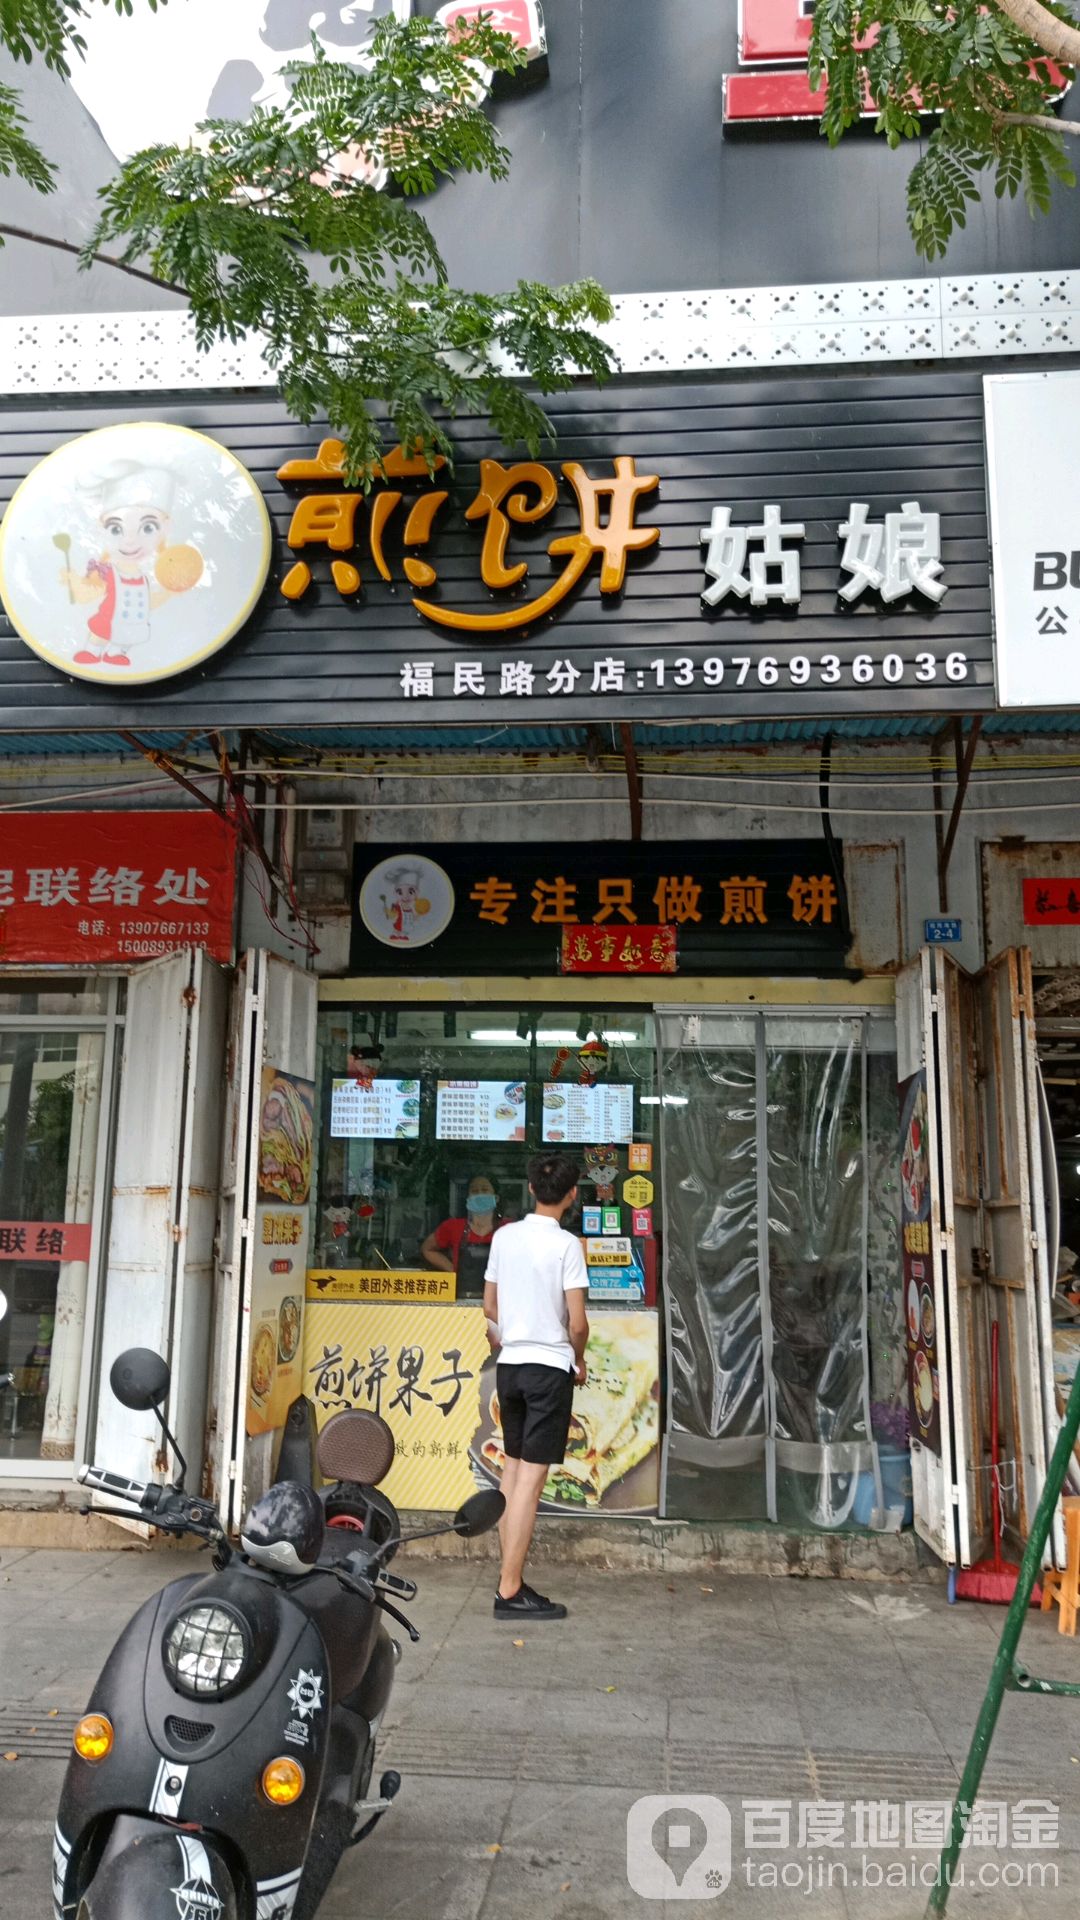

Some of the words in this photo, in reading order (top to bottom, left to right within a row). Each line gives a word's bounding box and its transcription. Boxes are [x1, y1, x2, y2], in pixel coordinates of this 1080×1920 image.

[700, 501, 948, 606] 姑娘
[1033, 550, 1080, 591] B
[469, 873, 837, 926] 专注只做煎饼
[119, 921, 209, 936] 13907667133
[359, 1276, 449, 1296] 美团外卖推荐商户
[309, 1344, 474, 1417] 煎饼果子
